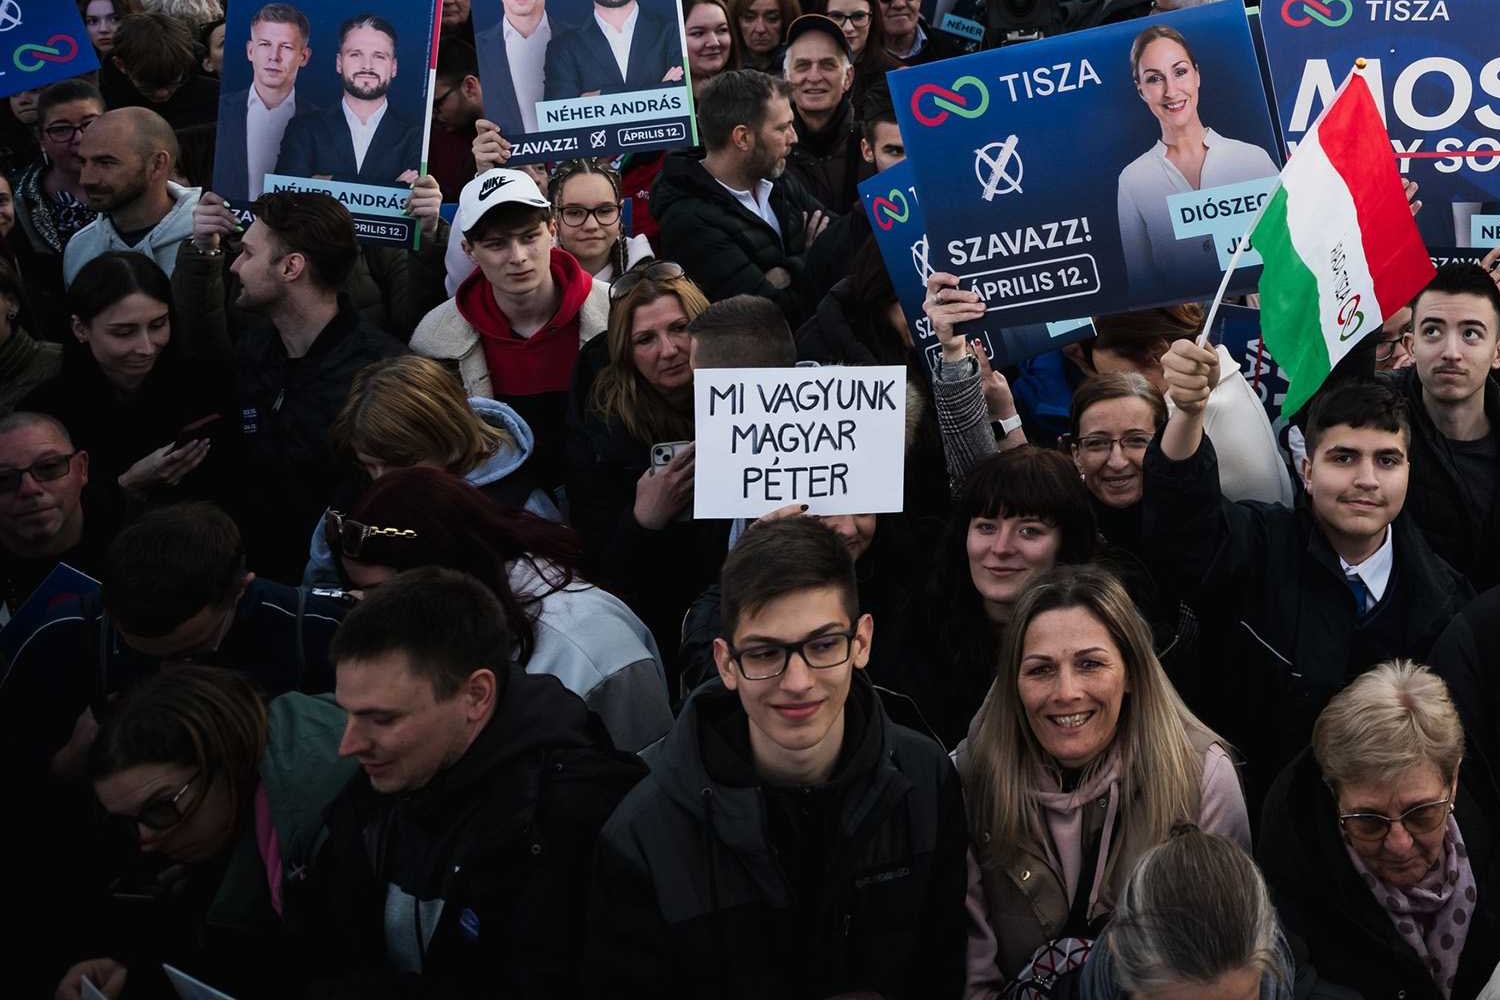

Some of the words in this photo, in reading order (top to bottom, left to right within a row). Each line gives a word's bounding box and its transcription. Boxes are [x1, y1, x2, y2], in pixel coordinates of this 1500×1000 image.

[1366, 0, 1450, 22] TISZA
[947, 19, 983, 37] NÉHER
[1000, 59, 1101, 102] TISZA
[546, 101, 605, 124] NÉHER
[608, 93, 681, 117] ANDRÁS
[623, 127, 666, 142] ÁPRILIS
[668, 125, 681, 137] 12.
[482, 175, 507, 192] NIKE
[1180, 193, 1269, 224] DIÓSZEG
[355, 222, 387, 235] PRILIS
[389, 227, 403, 237] 12.
[947, 217, 1093, 266] SZAVAZZ!
[969, 271, 1055, 303] ÁPRILIS
[1057, 267, 1089, 287] 12.
[709, 382, 744, 416] MI
[757, 377, 897, 414] VAGYUNK
[732, 419, 857, 455] MAGYAR
[743, 456, 849, 501] PÉTER
